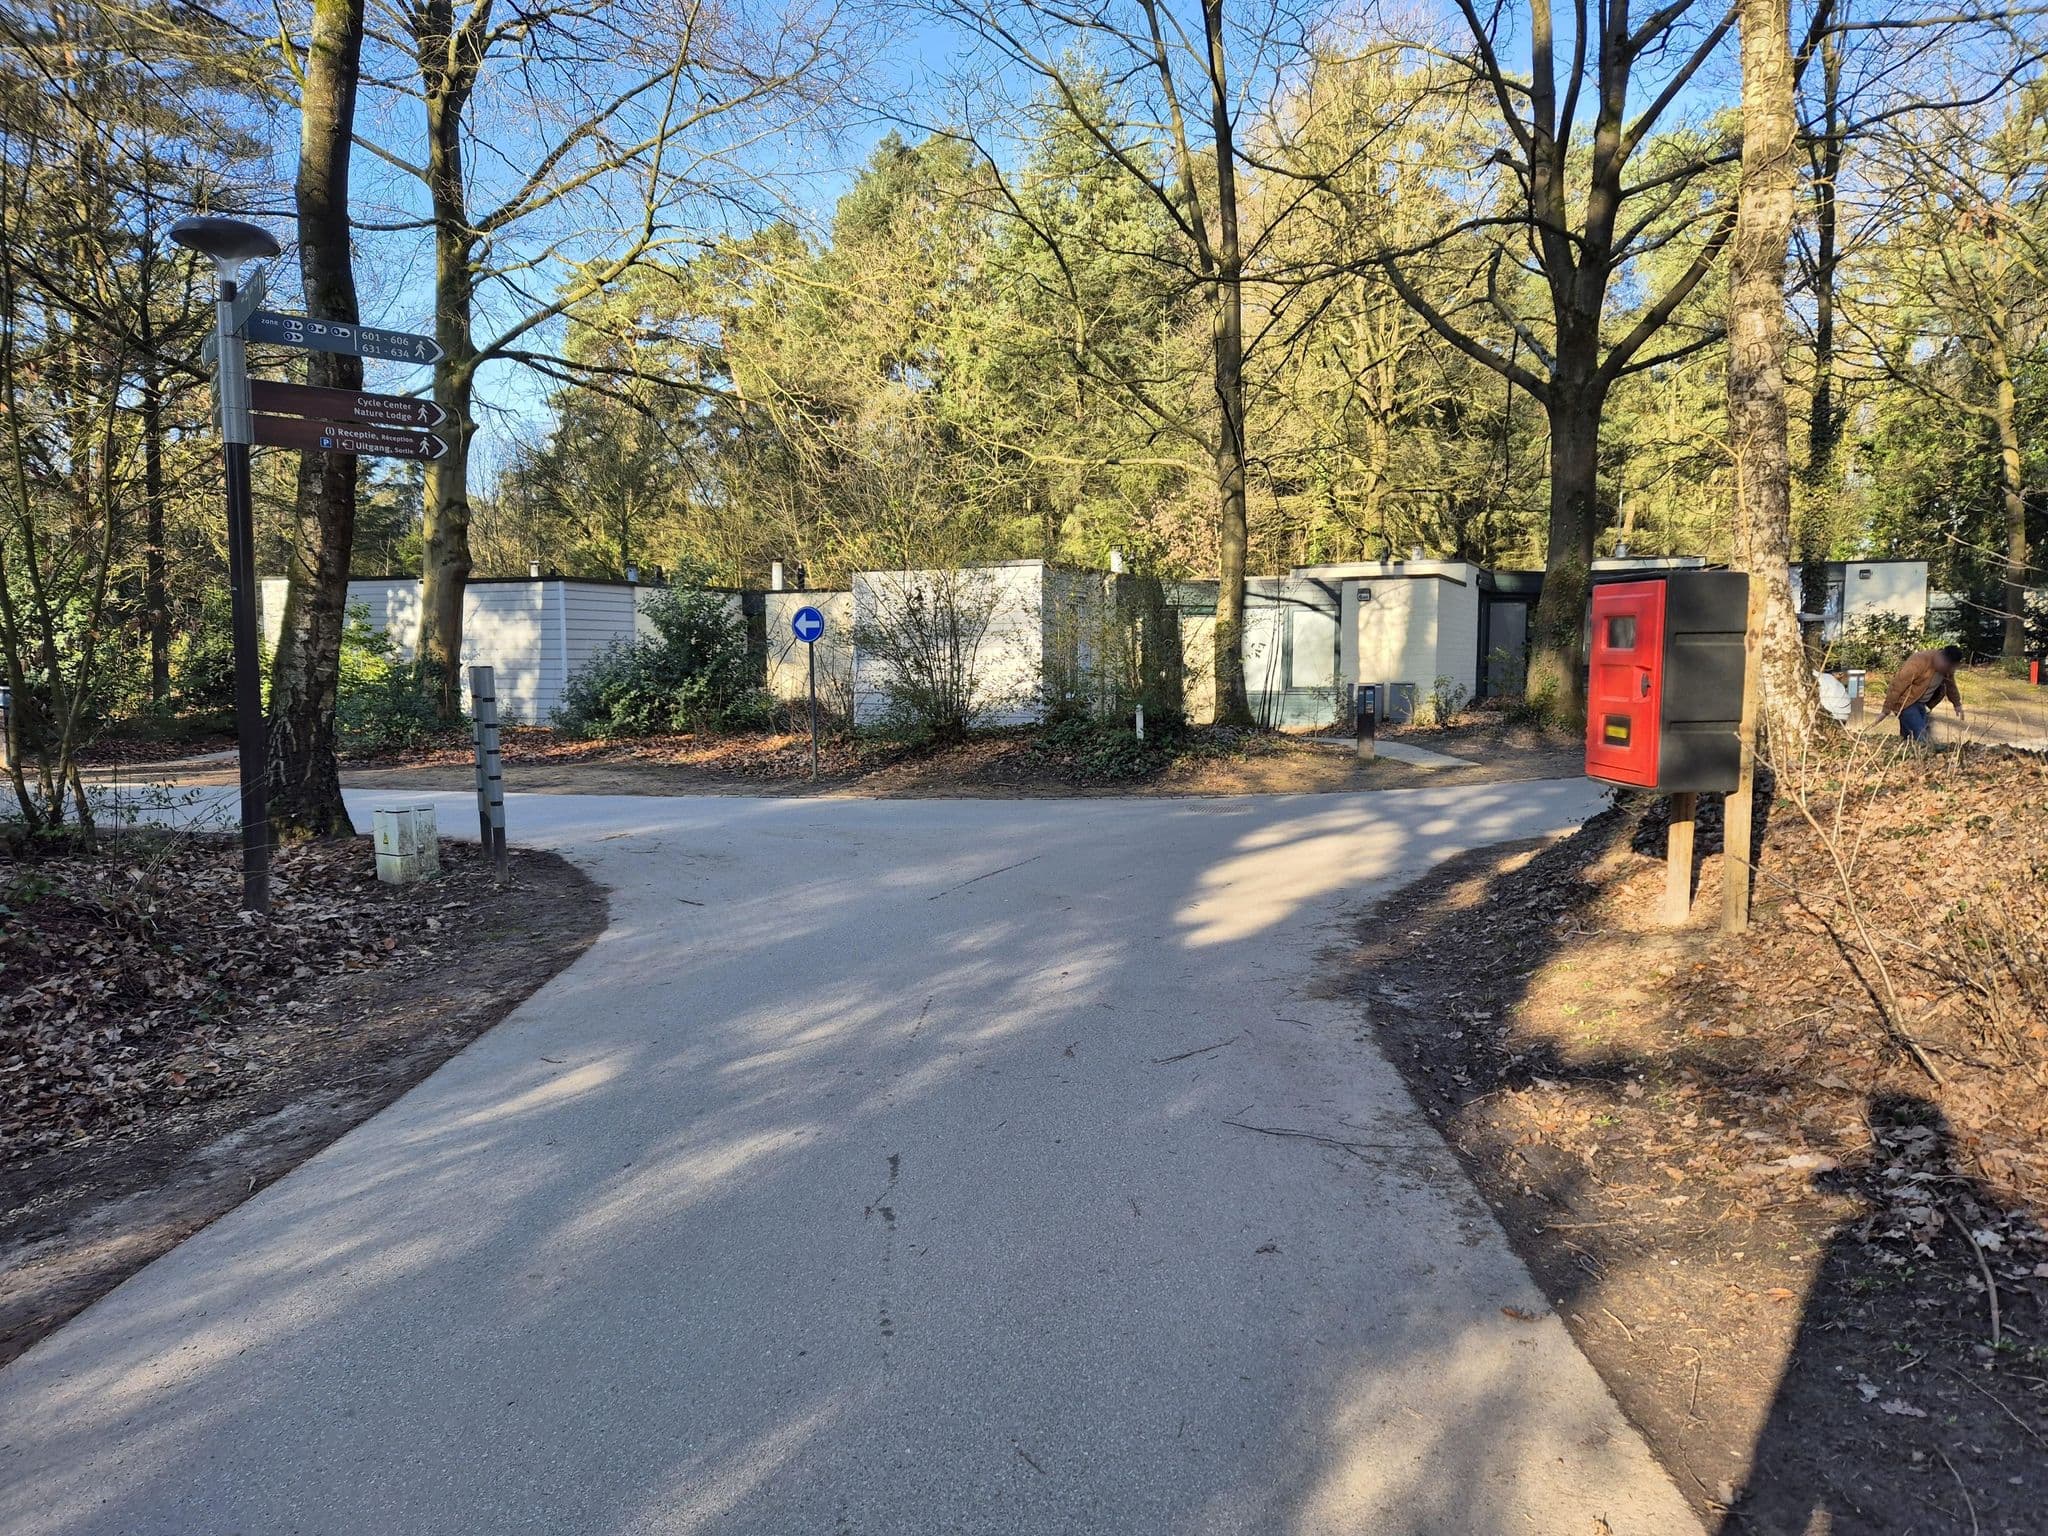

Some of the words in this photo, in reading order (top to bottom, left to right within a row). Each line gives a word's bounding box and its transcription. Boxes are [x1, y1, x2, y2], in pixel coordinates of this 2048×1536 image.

[362, 332, 380, 342] 601
[390, 336, 408, 346] 606
[362, 344, 380, 354] 631
[391, 348, 409, 358] 634
[358, 397, 382, 407] Cycle
[384, 400, 411, 410] Center
[354, 408, 384, 417] Nature
[386, 412, 412, 421] Lodge
[338, 428, 378, 440] Receptie,
[356, 442, 392, 453] Uitgang,
